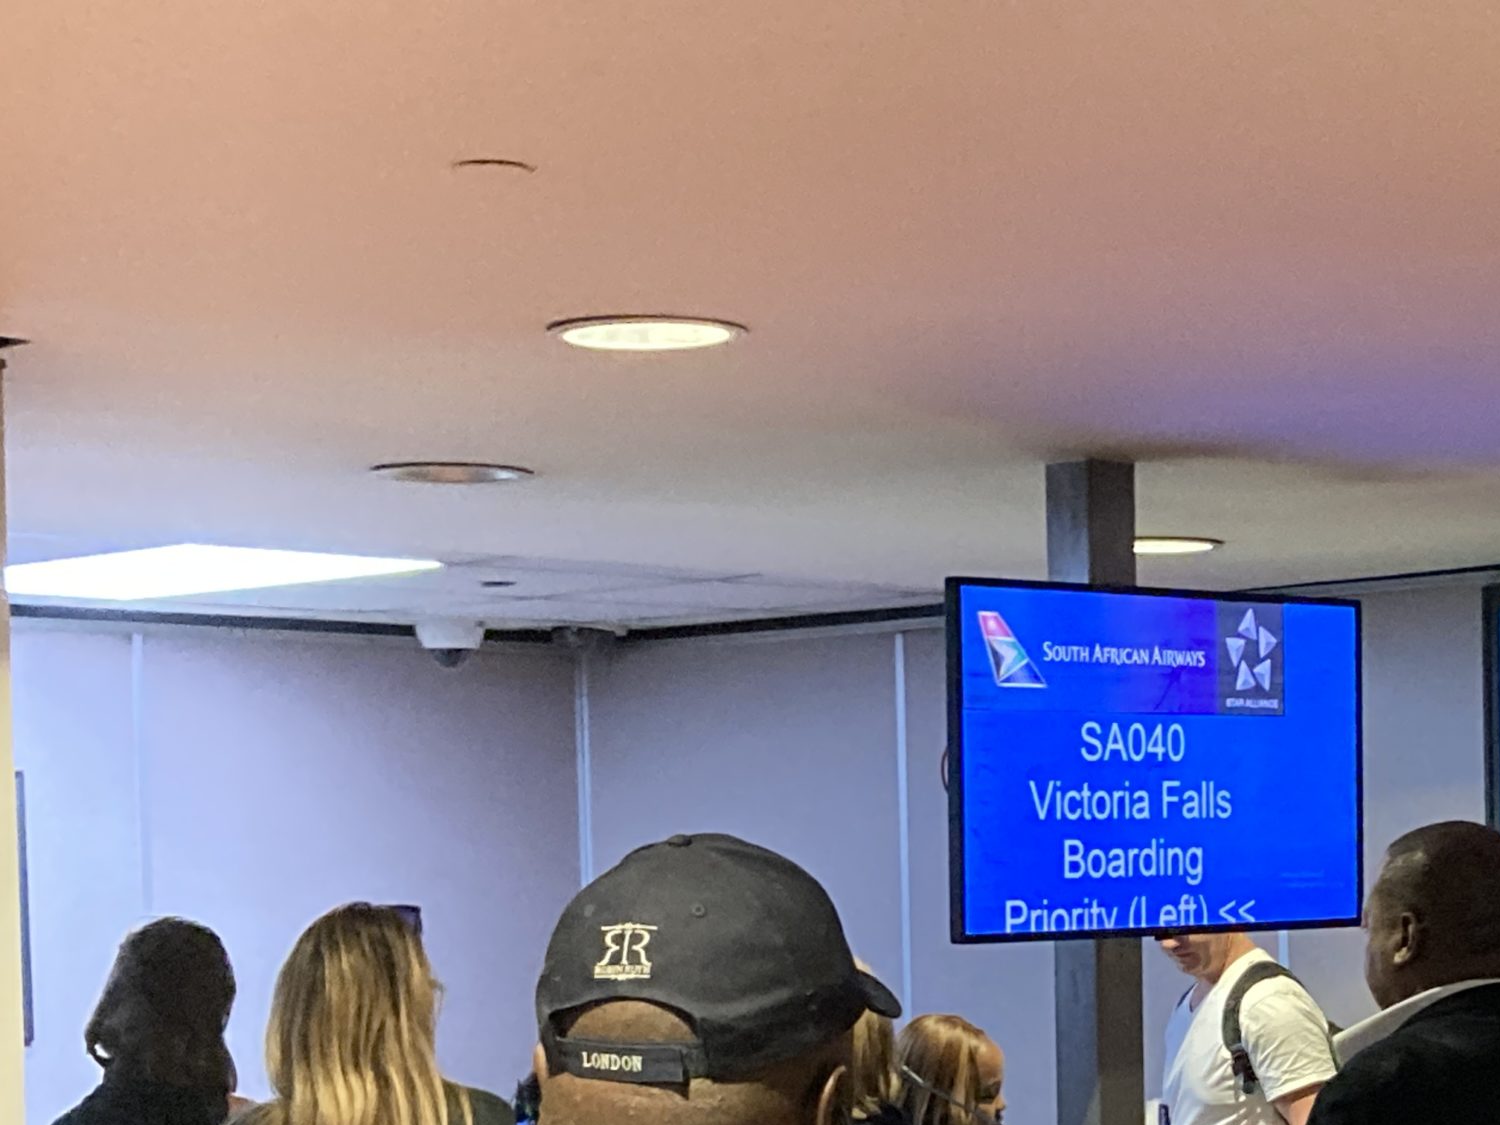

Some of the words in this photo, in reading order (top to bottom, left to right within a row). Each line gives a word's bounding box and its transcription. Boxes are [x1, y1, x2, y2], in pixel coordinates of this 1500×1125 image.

[1042, 641, 1090, 662] SOUTH
[1092, 643, 1150, 666] AFRICAN
[1151, 646, 1206, 667] AIRWAYS
[1080, 721, 1186, 762] SA040
[1029, 780, 1150, 821] Victoria
[1161, 780, 1232, 819] Falls
[1063, 838, 1204, 885] Boarding
[581, 1051, 643, 1072] LONDON
